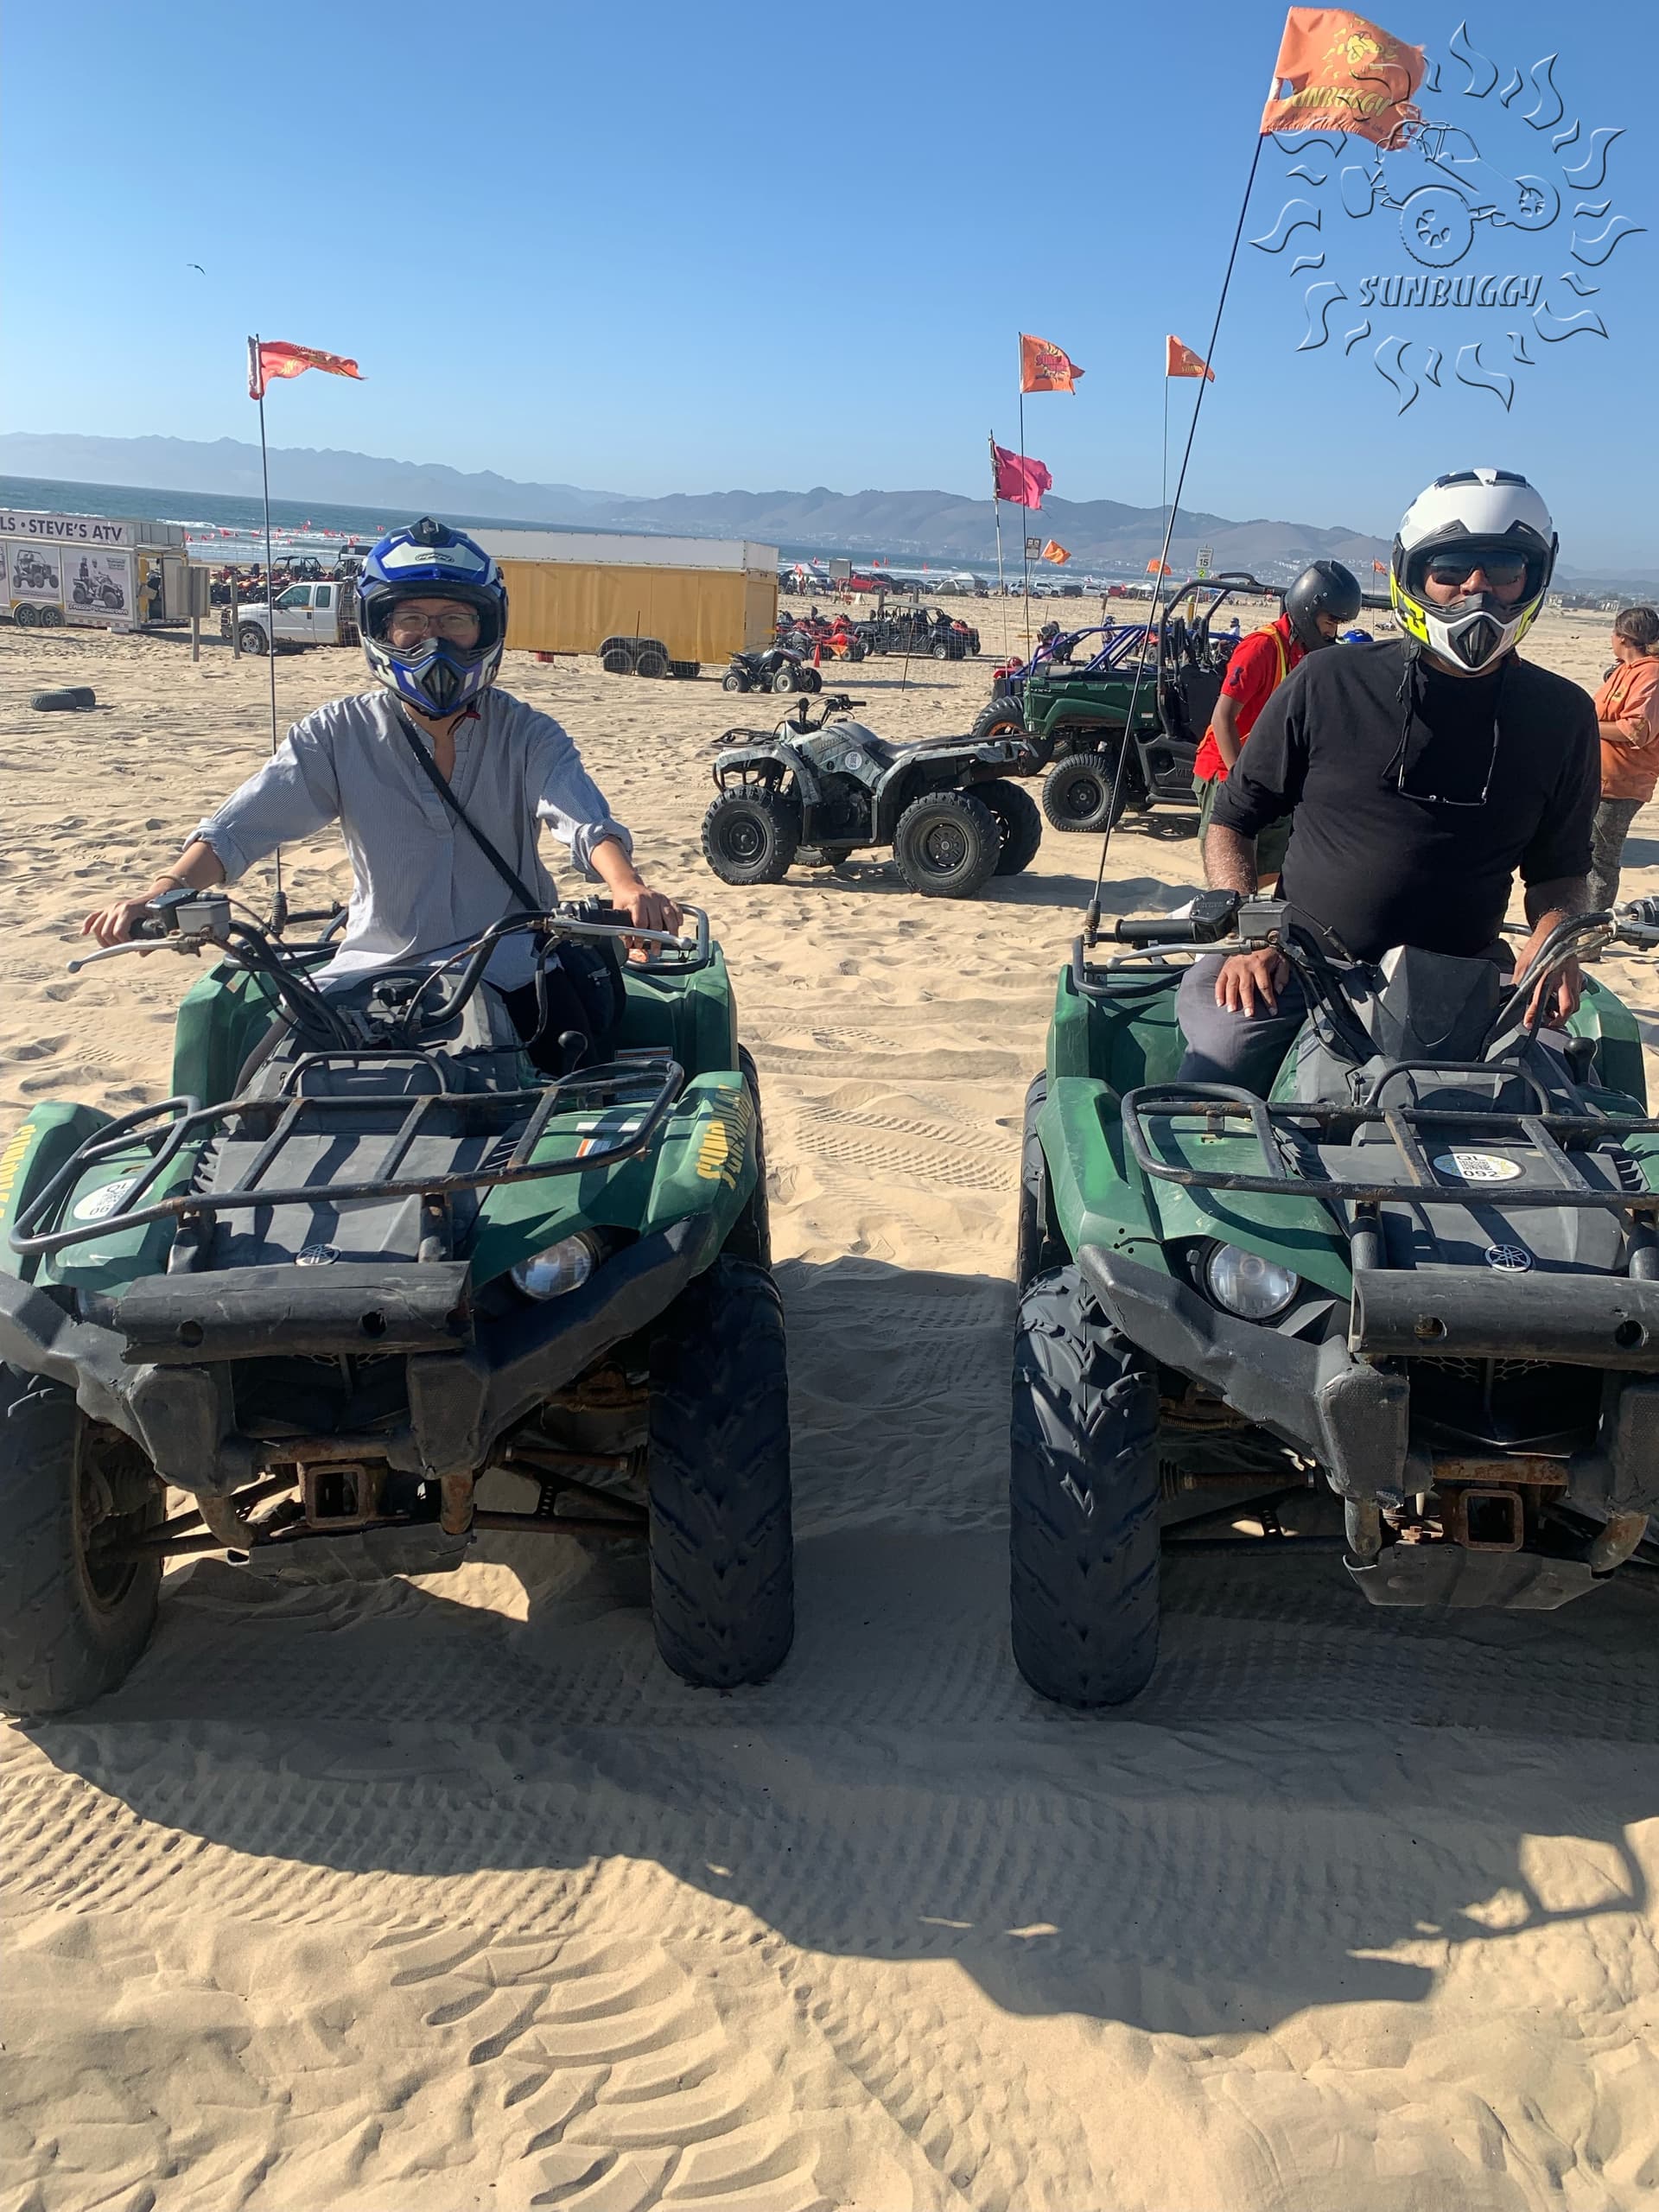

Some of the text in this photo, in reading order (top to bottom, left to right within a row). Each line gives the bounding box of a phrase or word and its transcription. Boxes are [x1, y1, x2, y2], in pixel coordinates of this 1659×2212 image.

[1291, 86, 1392, 118] UNBUGGY
[29, 519, 87, 538] STEVE'S
[92, 525, 123, 542] ATV
[1199, 558, 1209, 567] 15
